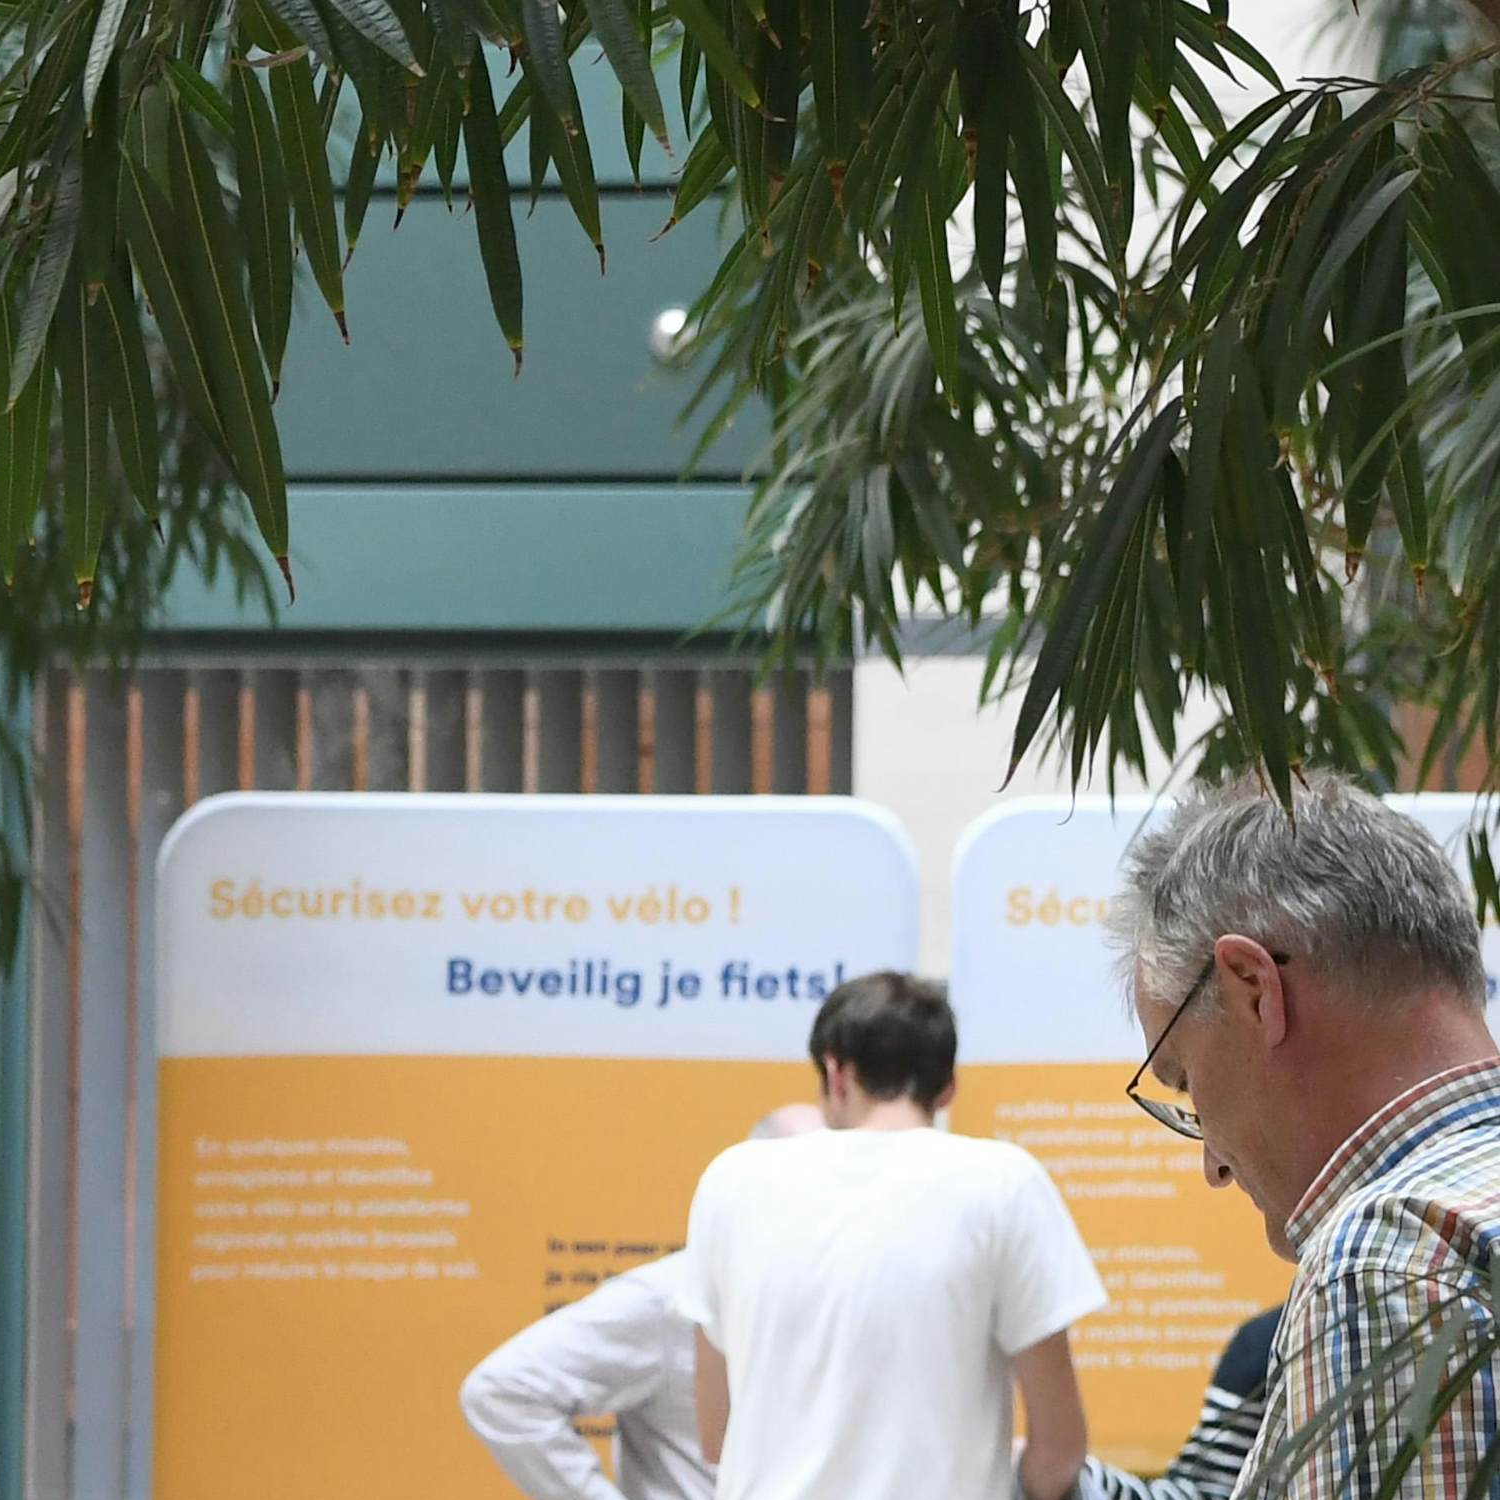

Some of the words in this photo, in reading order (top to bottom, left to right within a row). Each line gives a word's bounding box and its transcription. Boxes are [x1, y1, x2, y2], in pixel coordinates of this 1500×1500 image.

[208, 878, 443, 921] Sécurisez
[460, 886, 590, 923] votre
[609, 882, 712, 924] vélo
[729, 886, 743, 924] !
[446, 957, 642, 1007] Beveilig
[656, 960, 701, 1007] je
